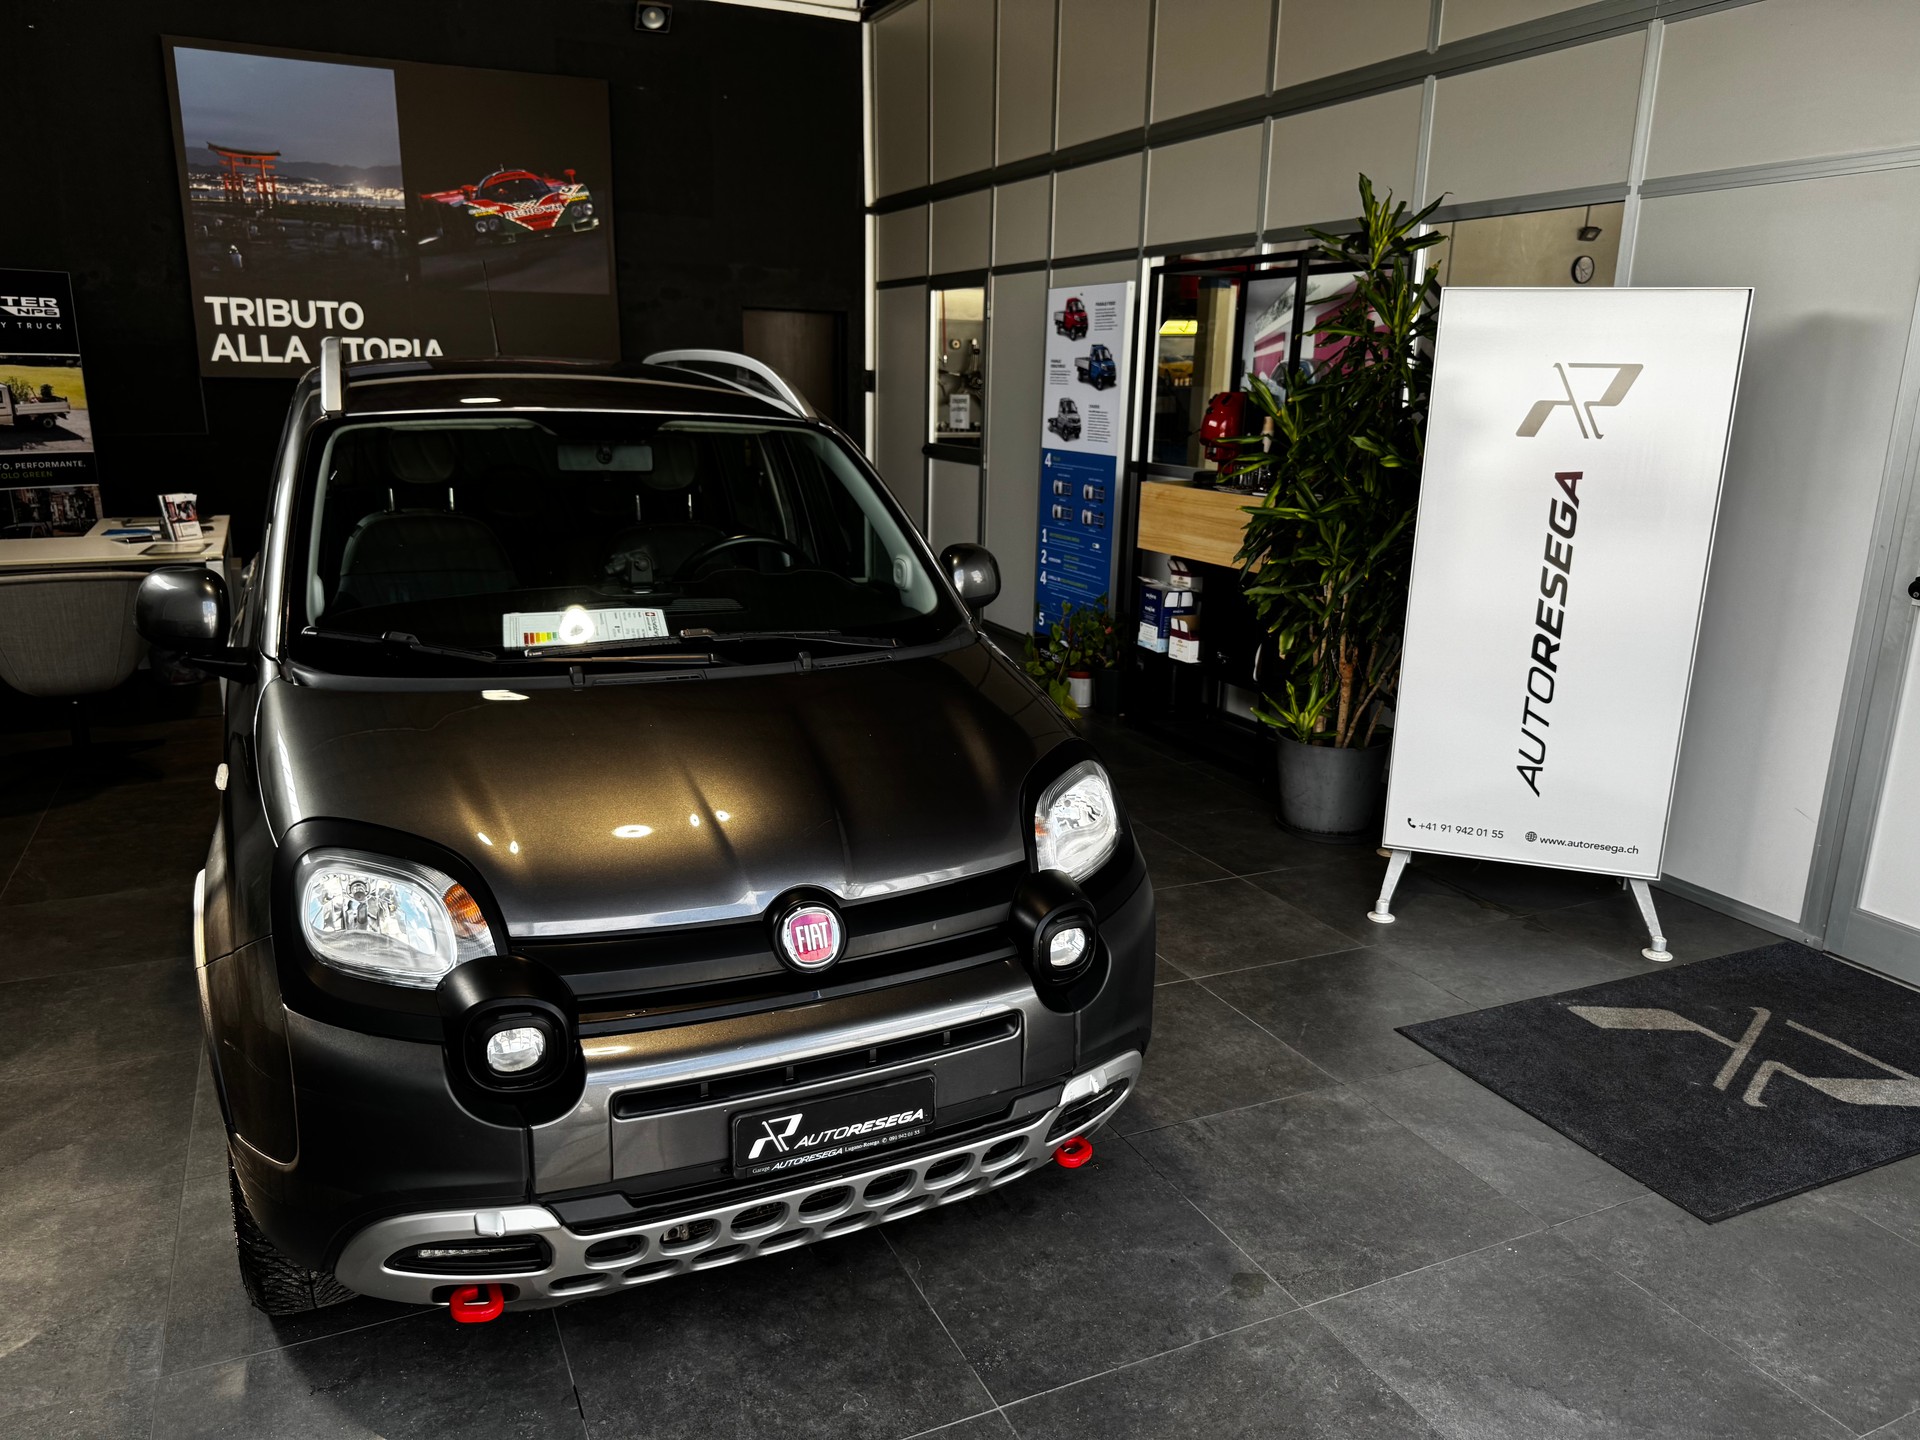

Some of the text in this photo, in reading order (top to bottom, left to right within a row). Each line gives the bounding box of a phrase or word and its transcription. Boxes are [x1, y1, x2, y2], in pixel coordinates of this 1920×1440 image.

[204, 295, 365, 331] TRIBUTO
[17, 322, 62, 330] TRUCK
[211, 333, 444, 364] ALLA TORIA
[1044, 452, 1053, 468] 4
[22, 471, 53, 479] GREEN
[1041, 527, 1048, 544] 1
[1040, 548, 1047, 565] 2
[1039, 570, 1047, 586] 4
[1038, 611, 1045, 627] 5
[1516, 471, 1584, 796] AUTORESEGA
[1419, 822, 1504, 839] +41 91 942 01 55
[1539, 836, 1639, 855] www.autoresega.ch
[795, 921, 828, 953] FIAT
[794, 1108, 924, 1150] AUTORESEGA
[752, 1165, 771, 1174] Garage
[771, 1147, 843, 1171] AUTORESEGA
